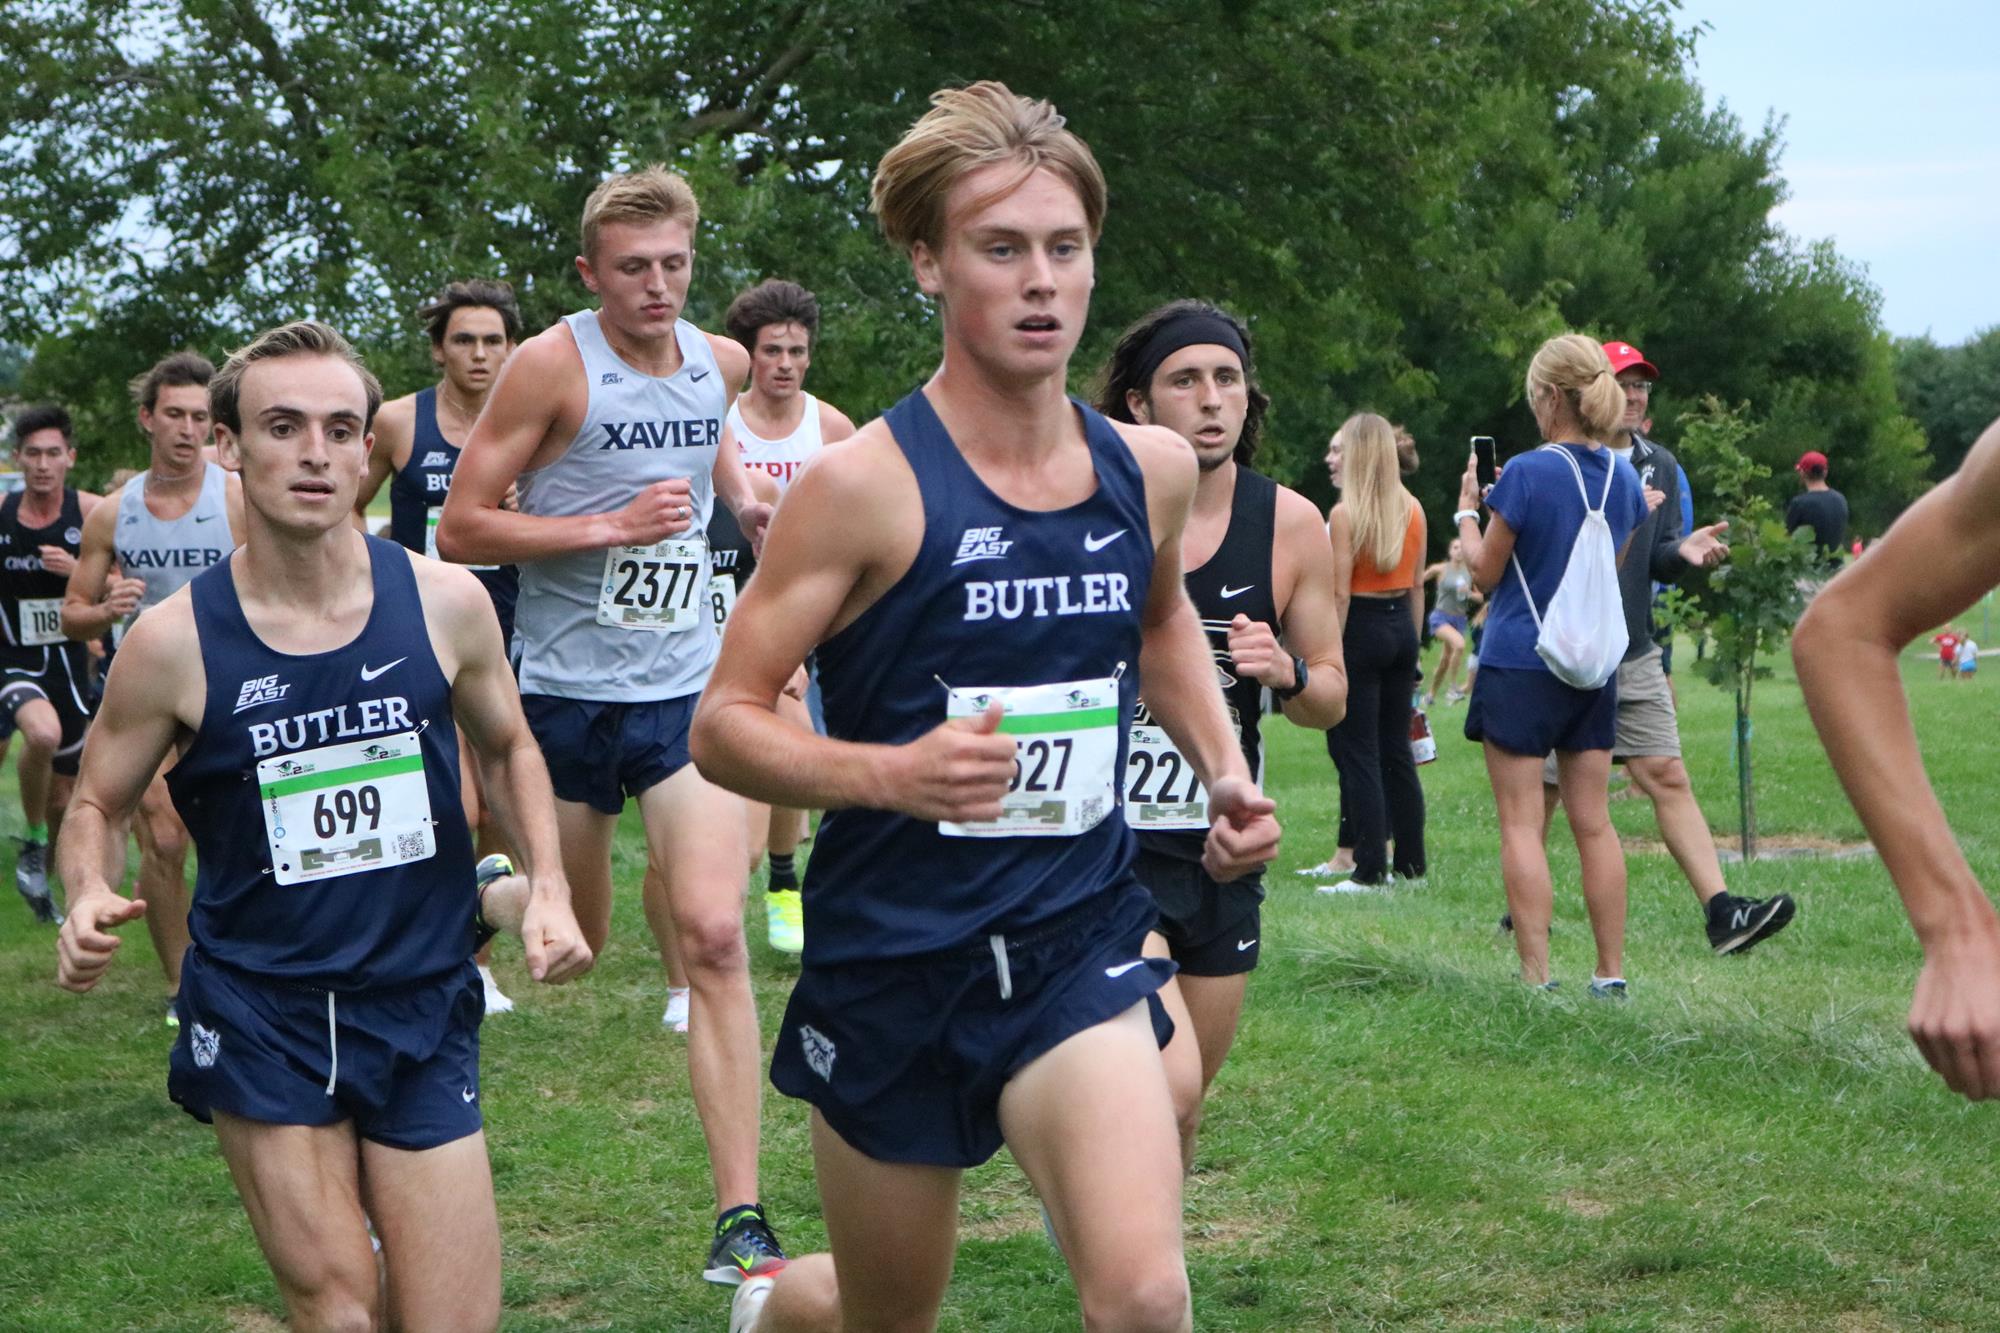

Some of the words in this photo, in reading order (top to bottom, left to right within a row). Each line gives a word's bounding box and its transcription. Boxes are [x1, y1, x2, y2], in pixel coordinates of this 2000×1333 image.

[599, 418, 720, 450] XAVIER
[956, 540, 1014, 558] EAST
[960, 526, 1003, 544] BIG
[120, 548, 222, 568] XAVIER
[613, 560, 699, 609] 2377
[963, 572, 1131, 621] BUTLER
[235, 683, 291, 708] EAST
[240, 674, 279, 695] BIG
[248, 696, 413, 758] BUTLER
[313, 784, 382, 840] 699
